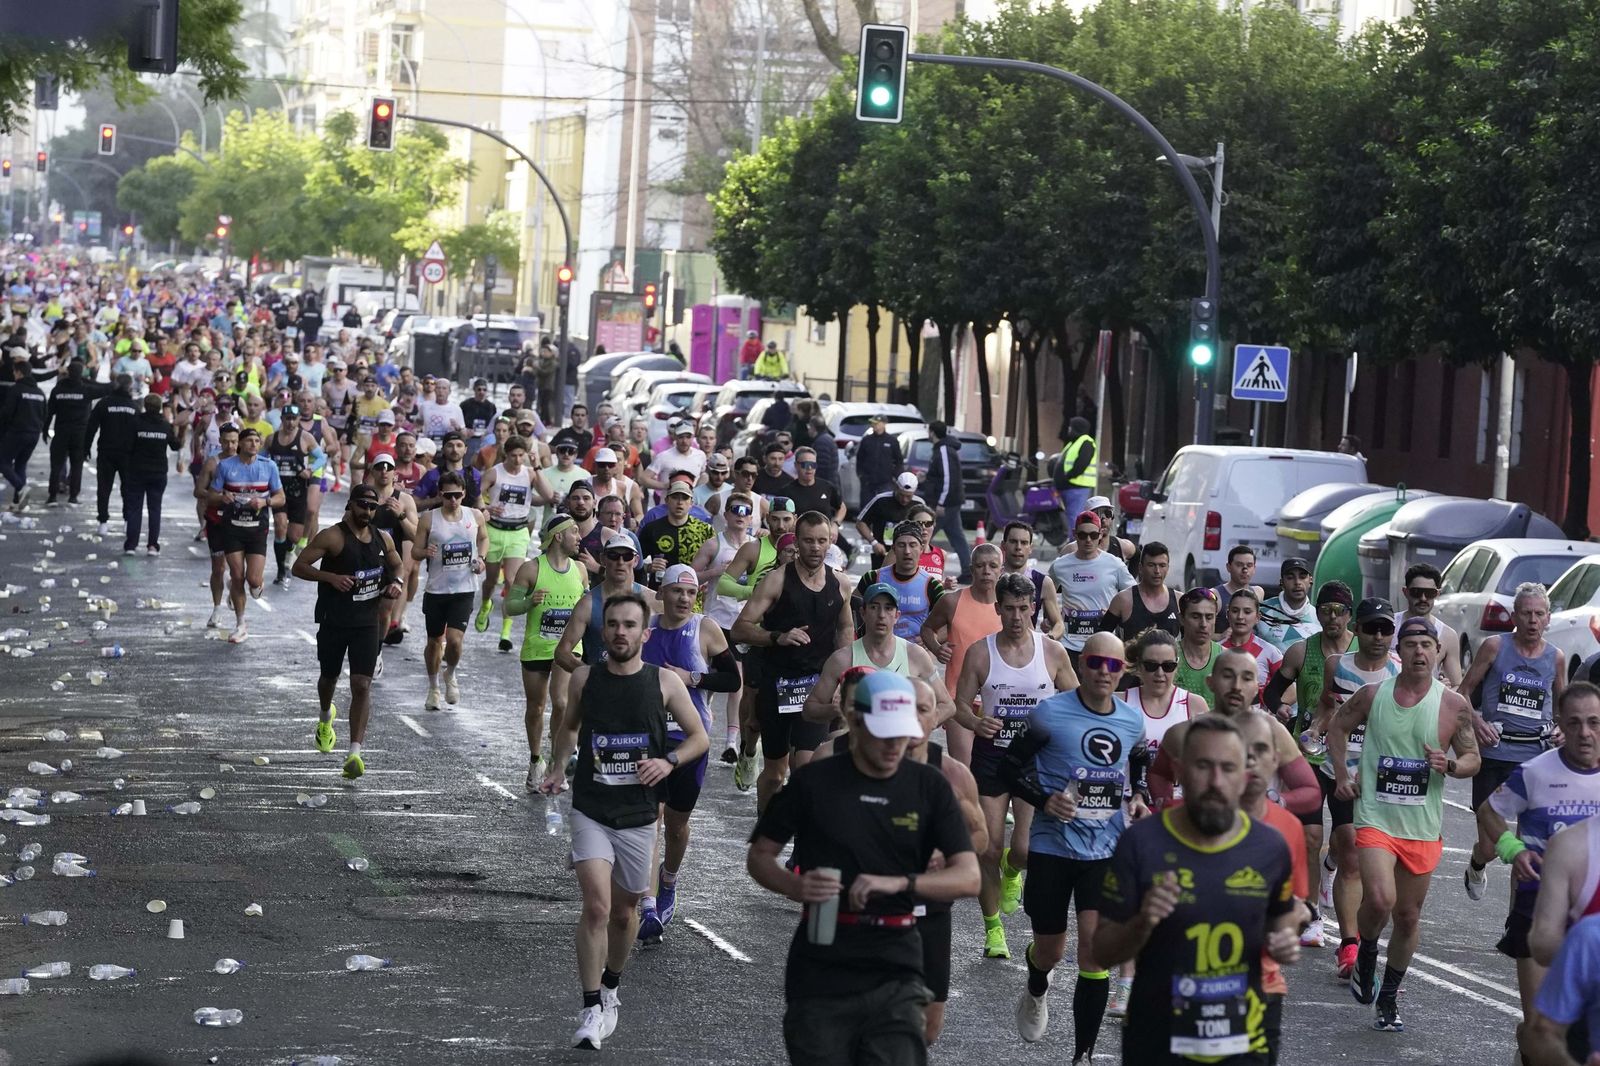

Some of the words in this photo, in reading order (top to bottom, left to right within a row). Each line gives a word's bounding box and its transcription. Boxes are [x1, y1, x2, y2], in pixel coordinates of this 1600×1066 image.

[1076, 627, 1094, 635] JOAN
[1518, 677, 1543, 687] ZURICH
[999, 697, 1038, 706] MARATHON
[1505, 694, 1538, 709] WALTER
[611, 736, 643, 745] ZURICH
[1396, 761, 1426, 769] ZURICH
[1090, 770, 1120, 779] ZURICH
[1385, 782, 1420, 795] PEPITO
[1078, 795, 1113, 807] ASCAL
[1185, 921, 1244, 972] 10
[1200, 980, 1241, 994] ZURICH
[1195, 1018, 1231, 1038] TONI
